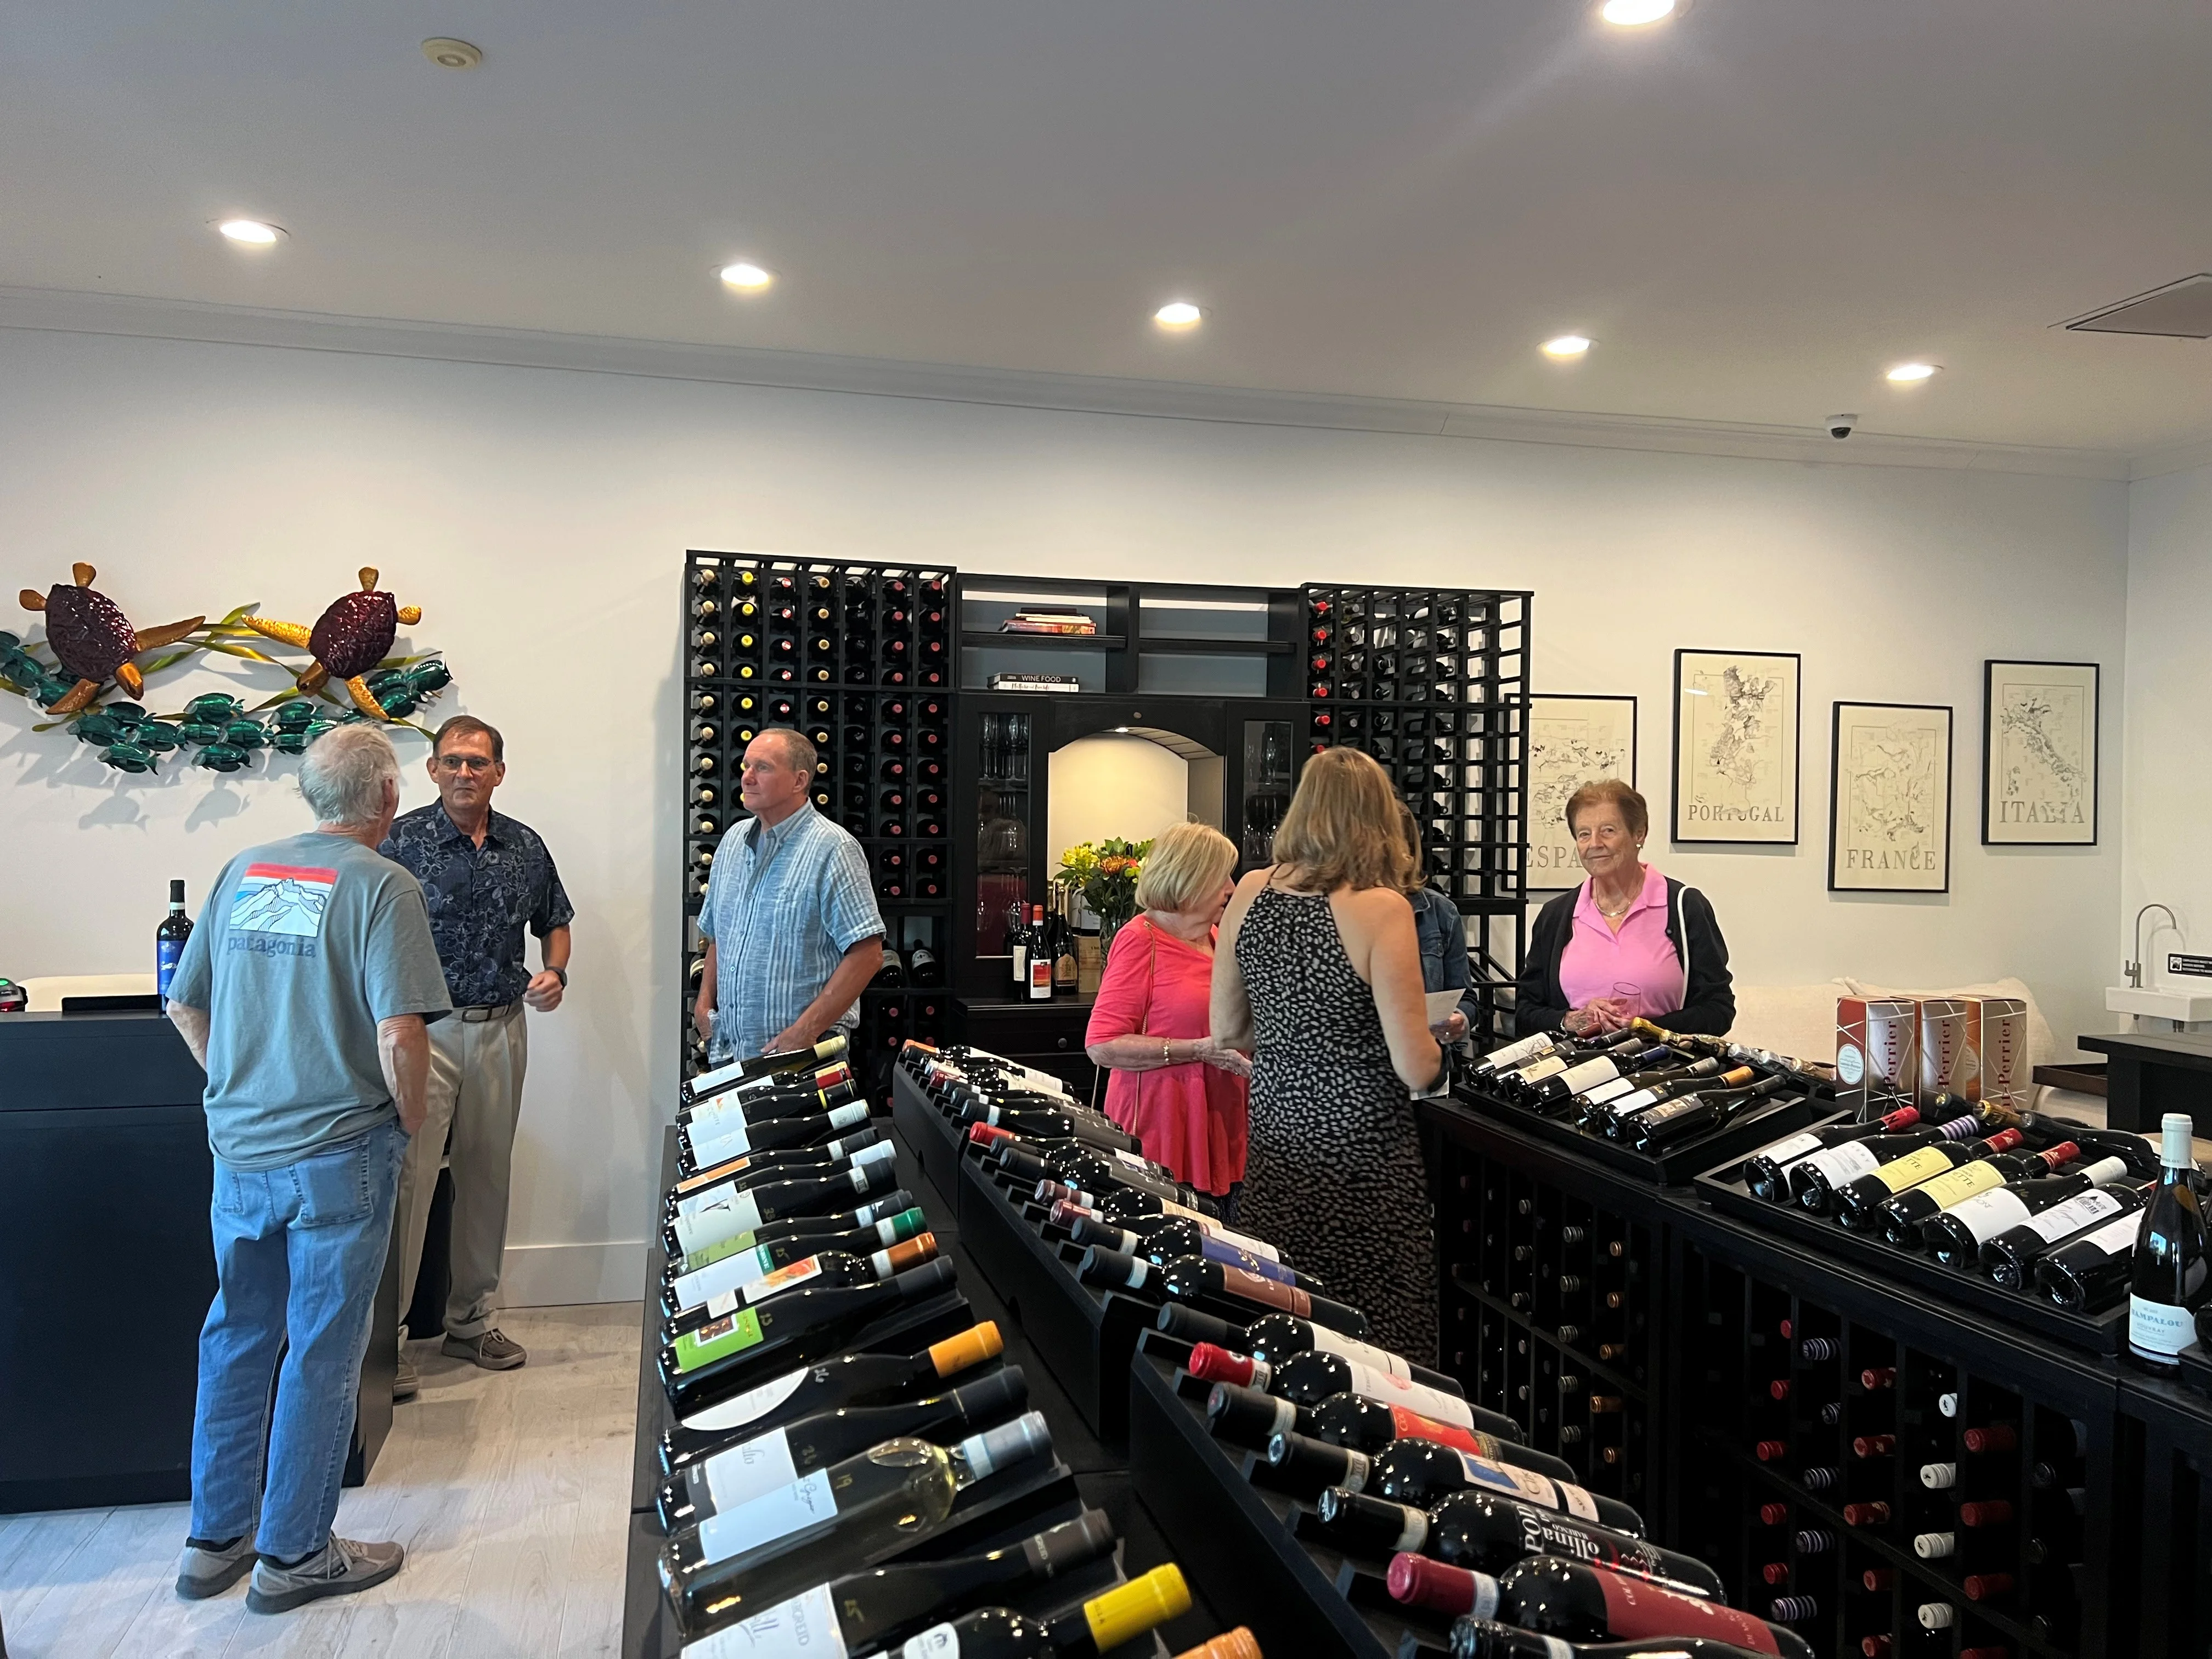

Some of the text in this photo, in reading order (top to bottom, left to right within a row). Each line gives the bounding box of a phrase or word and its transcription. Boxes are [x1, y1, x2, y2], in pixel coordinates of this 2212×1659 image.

[1688, 805, 1784, 822] PORTUGAL
[2000, 800, 2084, 823] ITALIA
[1526, 845, 1583, 868] ESPA
[1846, 849, 1936, 870] FRANCE
[227, 934, 316, 958] patagonia
[2131, 1308, 2183, 1327] HAMPALOU
